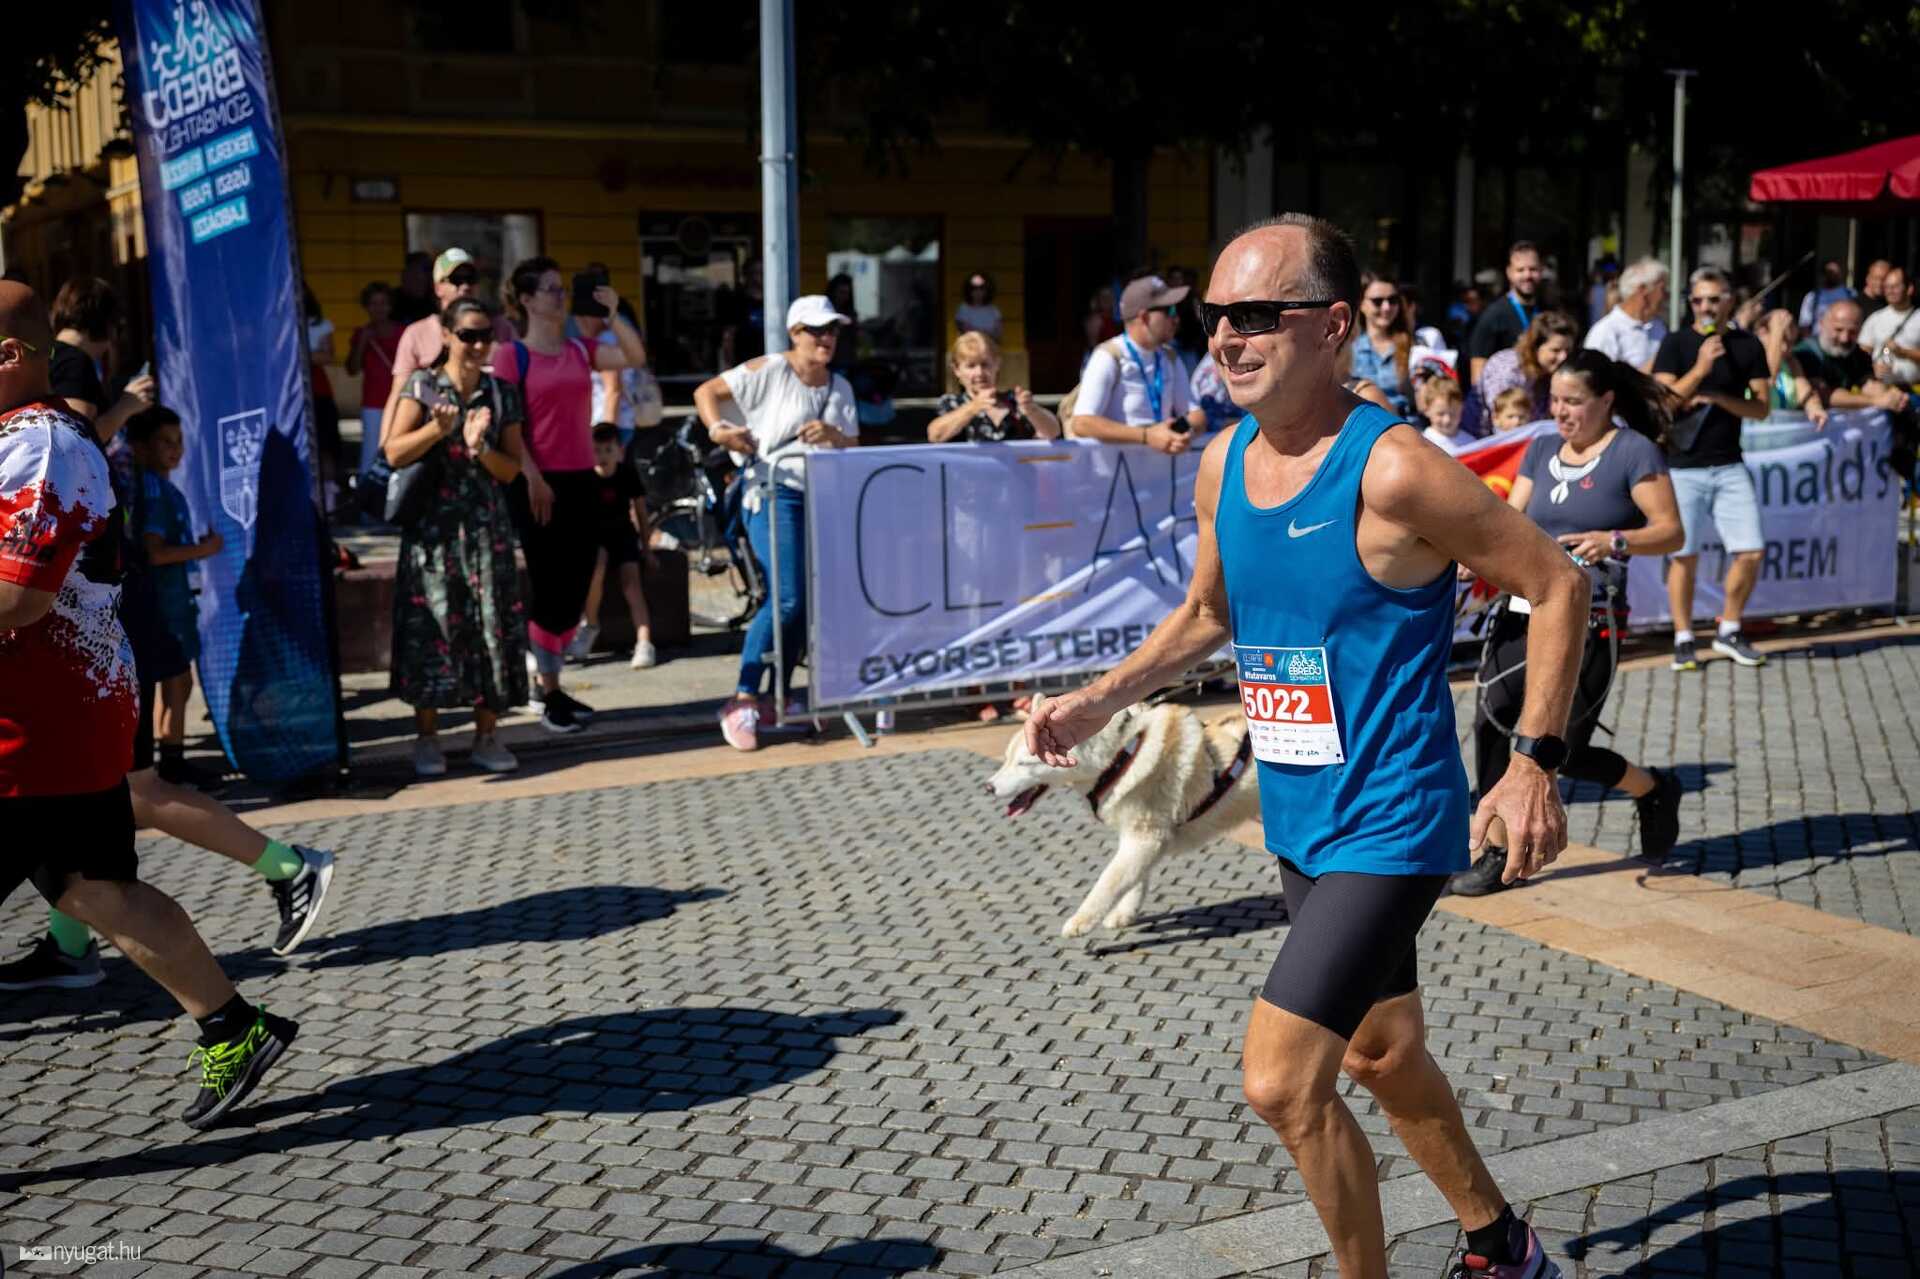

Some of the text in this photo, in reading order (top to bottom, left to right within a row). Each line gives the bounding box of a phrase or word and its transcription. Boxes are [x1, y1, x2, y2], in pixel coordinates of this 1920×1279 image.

[1752, 440, 1890, 506] nald's
[858, 622, 1156, 686] GYORSÉTTERE
[1243, 686, 1313, 721] 5022
